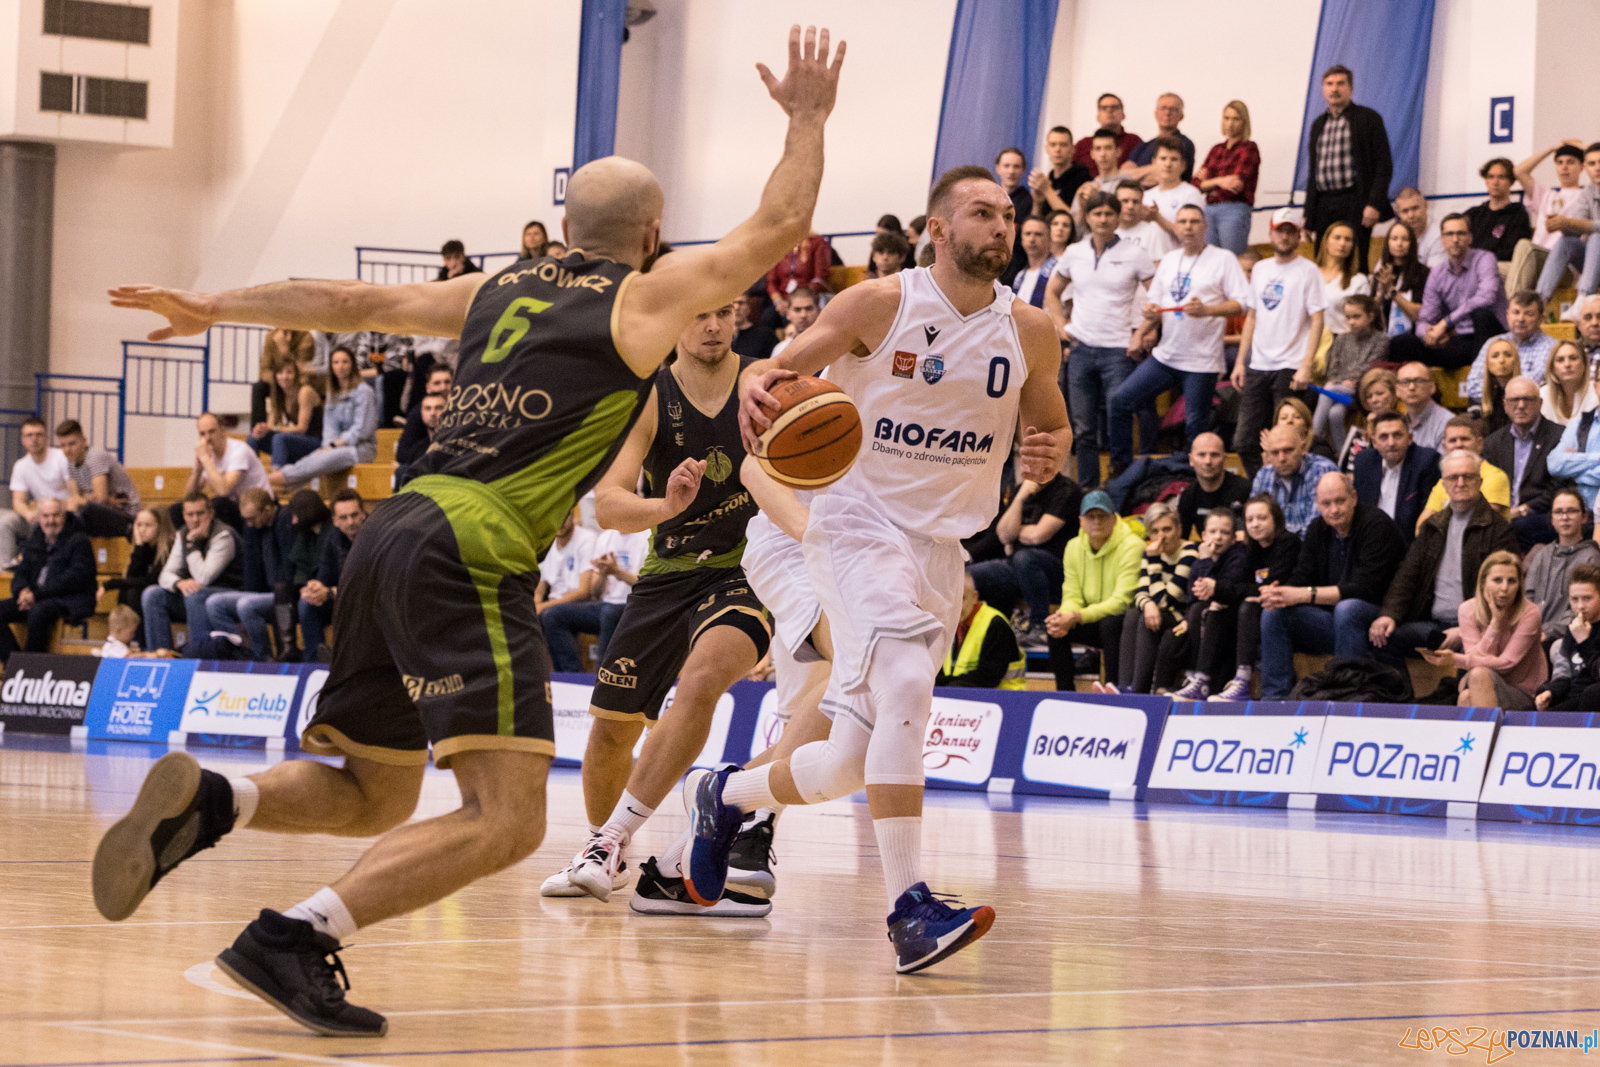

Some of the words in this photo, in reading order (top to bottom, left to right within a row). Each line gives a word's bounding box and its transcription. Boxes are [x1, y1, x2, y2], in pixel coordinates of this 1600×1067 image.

[1494, 102, 1511, 137] C
[480, 296, 555, 363] 6
[986, 356, 1010, 398] 0
[443, 382, 553, 420] ROSNO
[874, 417, 996, 453] BIOFARM
[872, 441, 905, 458] Dbamy
[905, 451, 912, 459] o
[913, 451, 951, 465] zdrowie
[951, 456, 988, 467] pacjentów
[1, 669, 92, 707] drukma
[599, 669, 634, 687] ORLEN
[109, 702, 157, 725] HOTEL
[217, 690, 287, 712] funclub
[933, 711, 983, 732] leniwej
[926, 728, 981, 752] Danuty
[1033, 734, 1129, 760] BIOFARM
